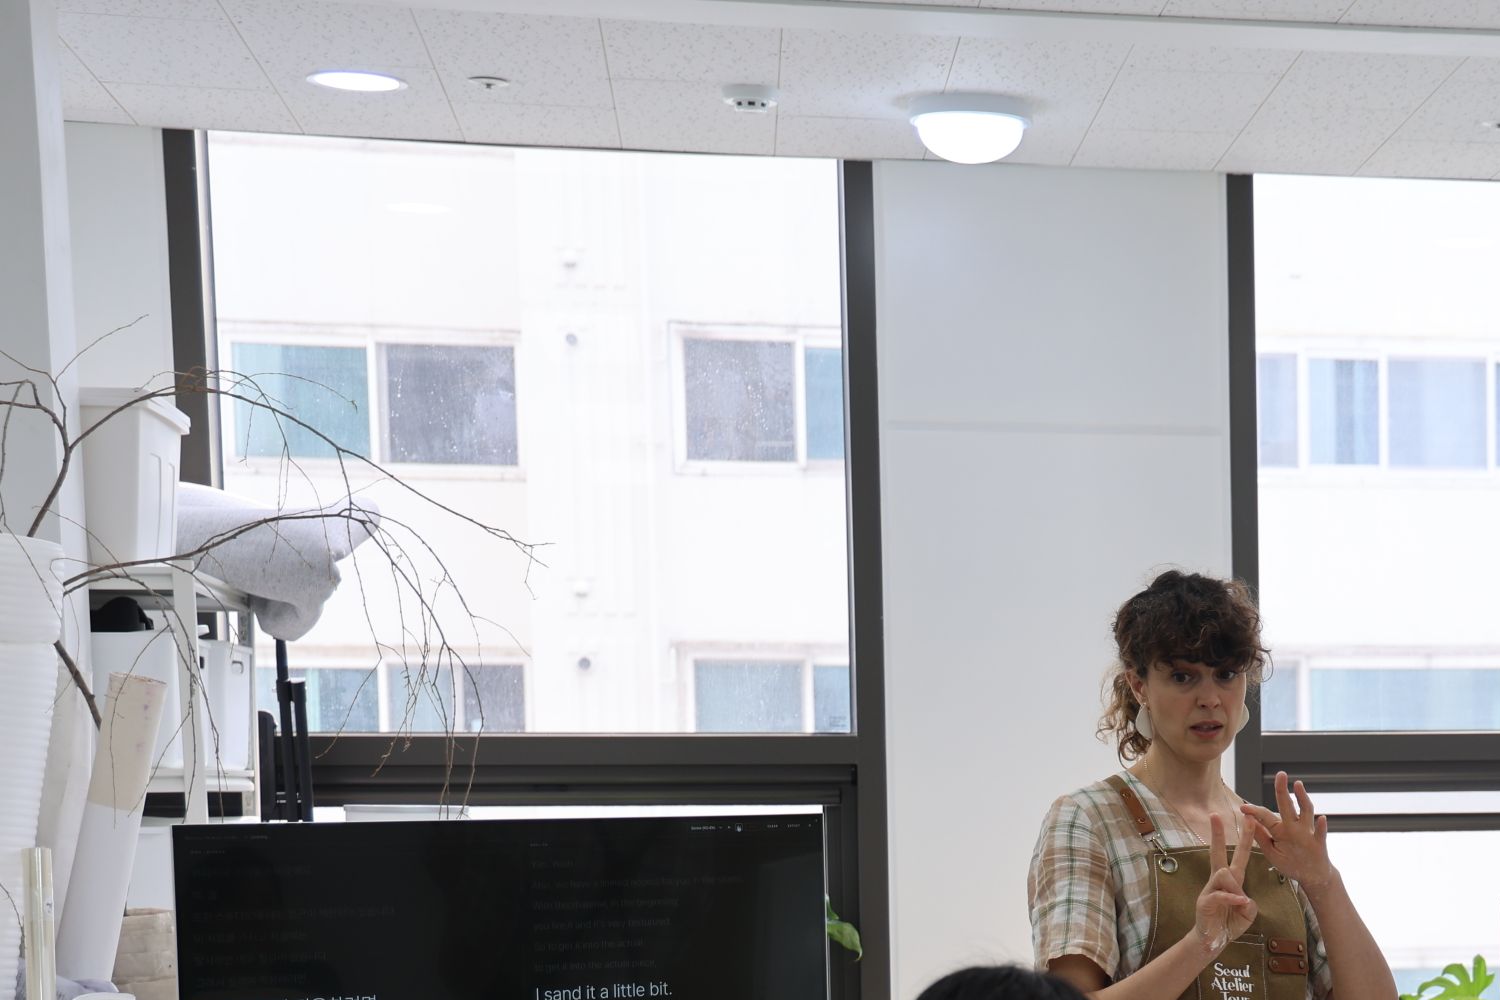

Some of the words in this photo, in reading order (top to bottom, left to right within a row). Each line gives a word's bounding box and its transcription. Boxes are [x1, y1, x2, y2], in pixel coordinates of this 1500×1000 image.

[1213, 962, 1250, 977] Seoul
[586, 984, 596, 1000] it
[599, 987, 609, 999] a
[613, 982, 646, 999] little
[649, 981, 673, 997] bit.
[1211, 976, 1254, 992] Atelier
